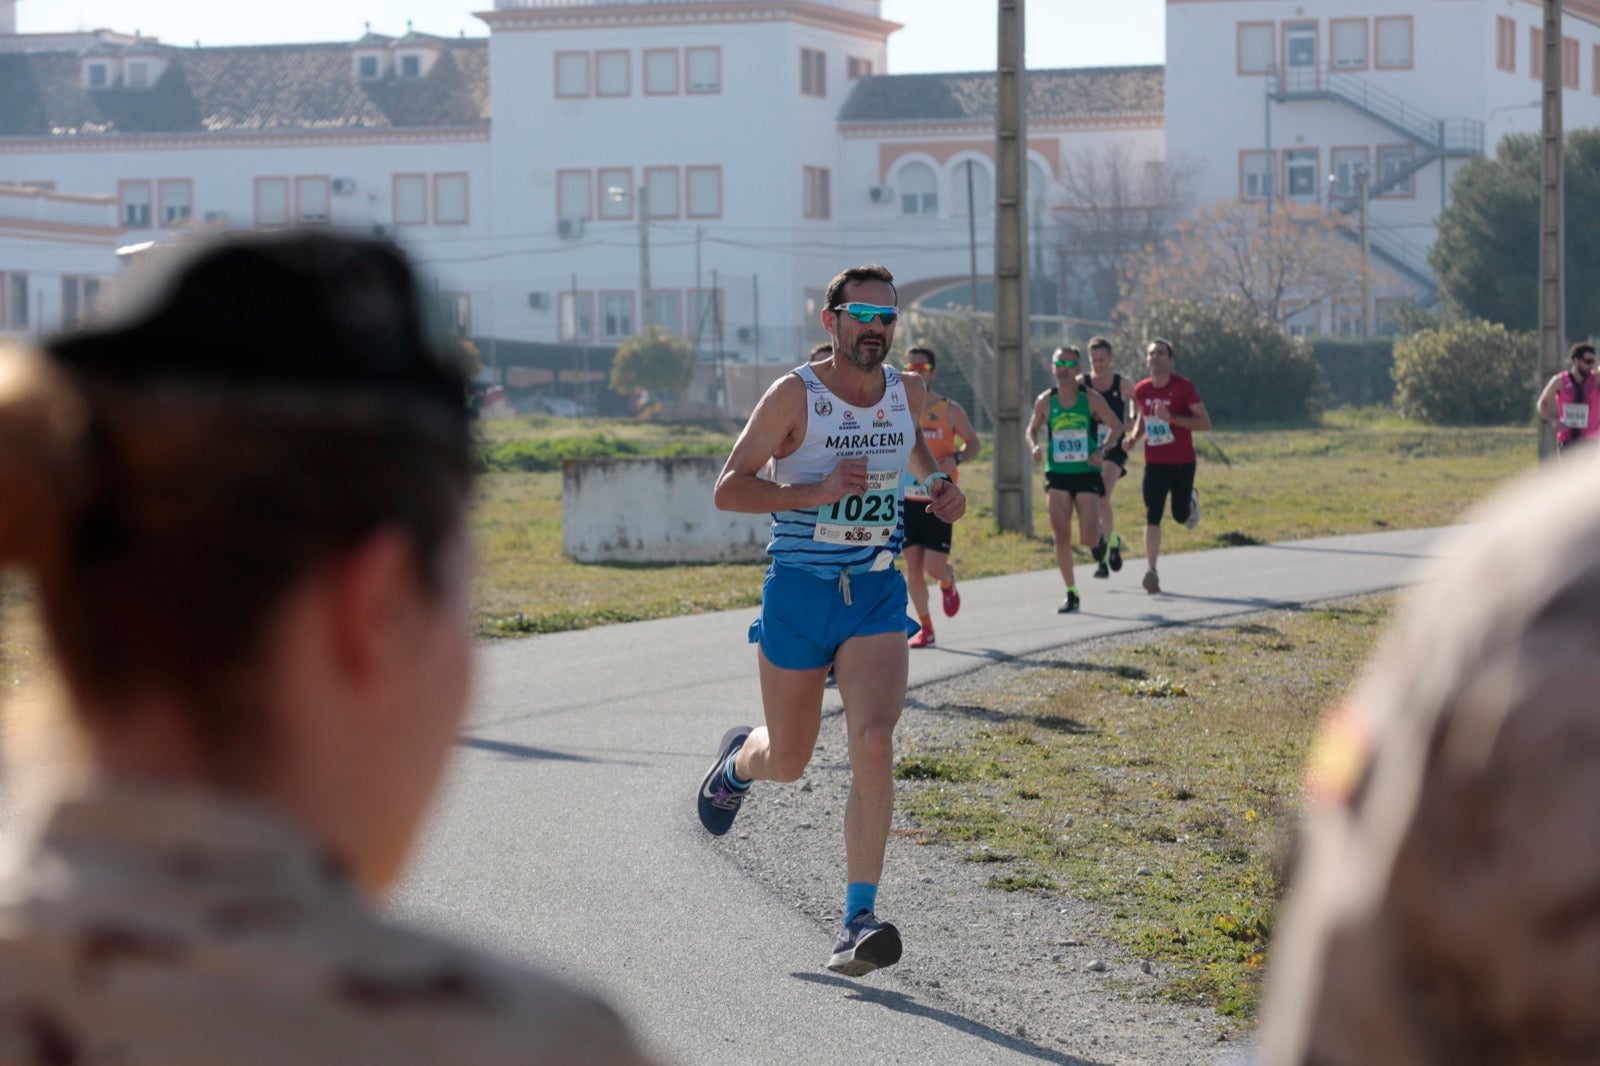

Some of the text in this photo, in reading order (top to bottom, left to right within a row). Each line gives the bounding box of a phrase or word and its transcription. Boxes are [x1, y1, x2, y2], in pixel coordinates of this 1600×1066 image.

[825, 431, 904, 450] MARACENA
[1058, 440, 1081, 452] 639
[864, 448, 897, 456] ATLETISMO
[826, 494, 895, 521] 1023
